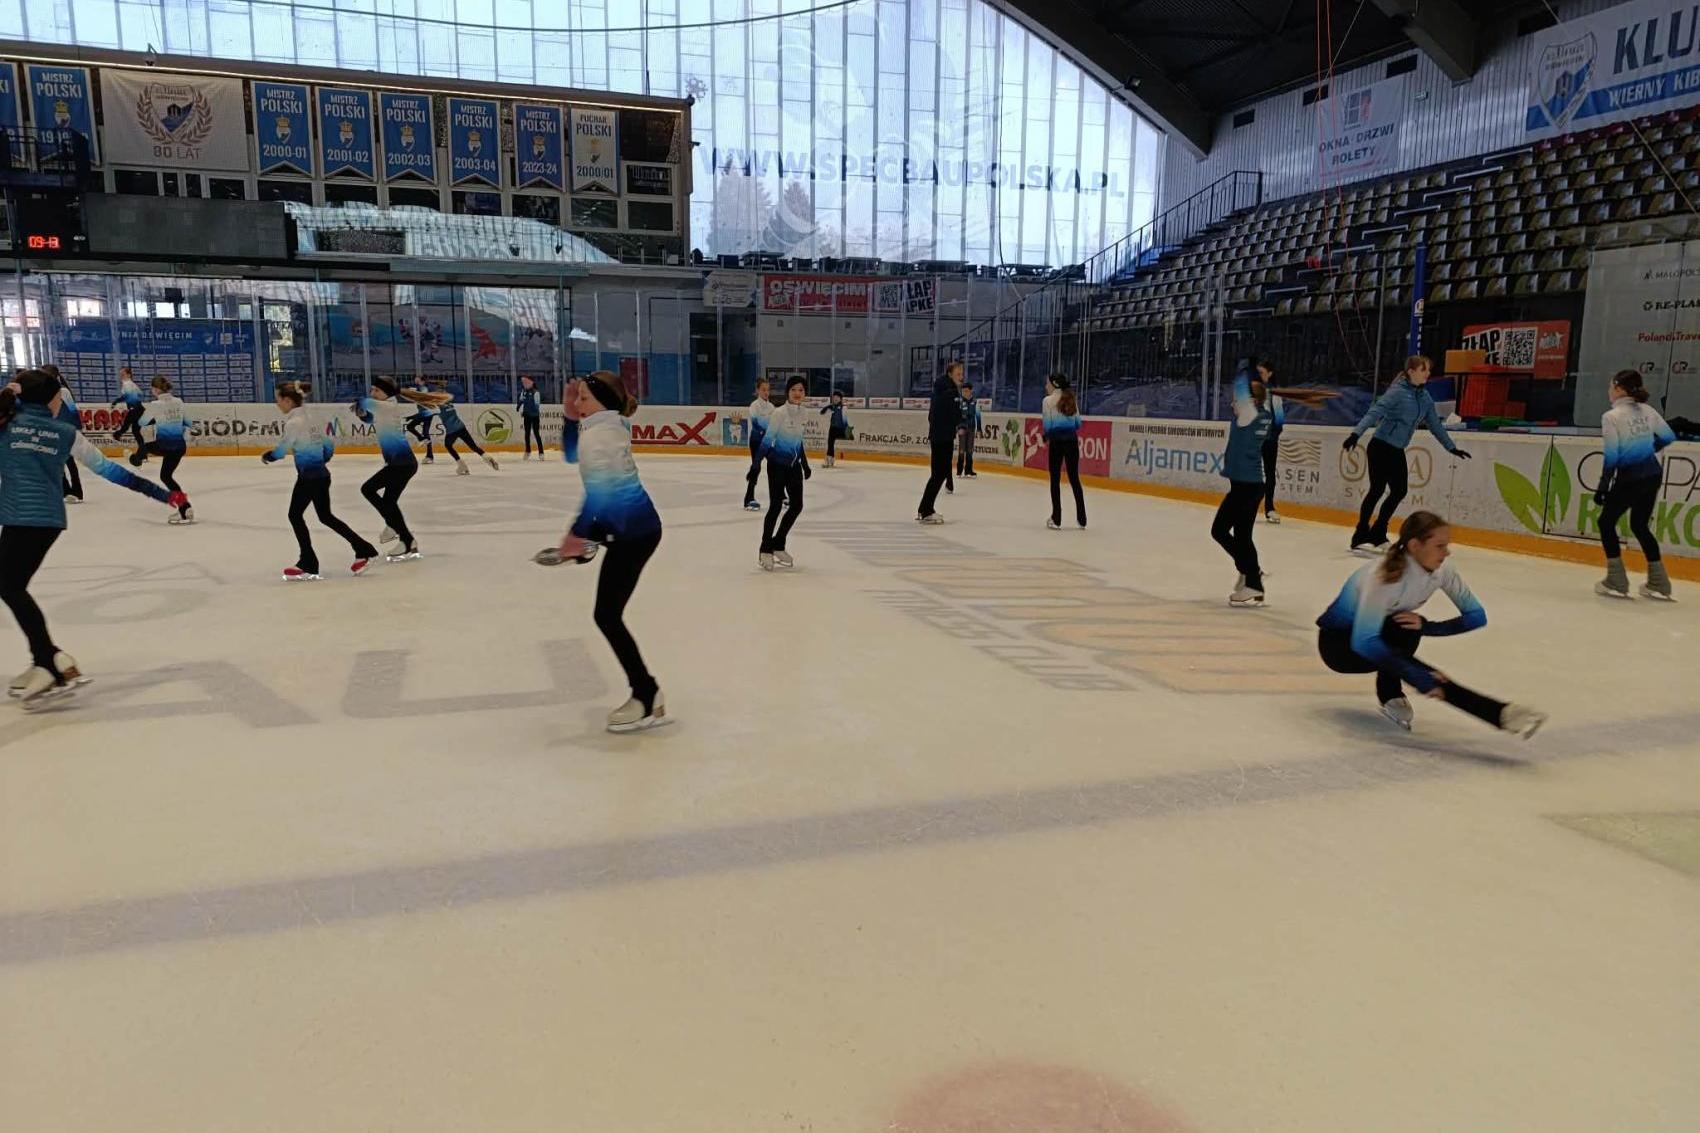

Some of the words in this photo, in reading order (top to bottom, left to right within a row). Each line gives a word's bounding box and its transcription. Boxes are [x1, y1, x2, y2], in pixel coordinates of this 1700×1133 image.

[1613, 4, 1700, 75] KLU
[41, 72, 73, 84] MISTRZ
[36, 83, 82, 98] POLSKI
[266, 88, 295, 100] MISTRZ
[1608, 77, 1665, 107] WIERNY
[330, 94, 358, 105] MISTRZ
[392, 99, 419, 110] MISTRZ
[260, 101, 303, 114] POLSKI
[324, 104, 365, 119] POLSKI
[461, 104, 487, 116] MISTRZ
[525, 109, 551, 121] MISTRZ
[386, 109, 426, 124] POLSKI
[454, 113, 493, 128] POLSKI
[520, 119, 556, 134] POLSKI
[576, 122, 612, 137] POLSKI
[1319, 135, 1350, 153] OKNA
[1356, 123, 1394, 143] DRZWI
[153, 146, 172, 159] 80
[176, 146, 201, 160] LAT
[263, 143, 307, 160] 2000-01
[327, 149, 369, 163] 2001-02
[388, 151, 431, 167] 2002-03
[1332, 146, 1376, 165] ROLETY
[454, 157, 496, 173] 2003-04
[522, 161, 558, 176] 2023-24
[698, 145, 1125, 199] WWW.SPECBAUPOLSKA.PL
[1125, 438, 1225, 475] Aljamex
